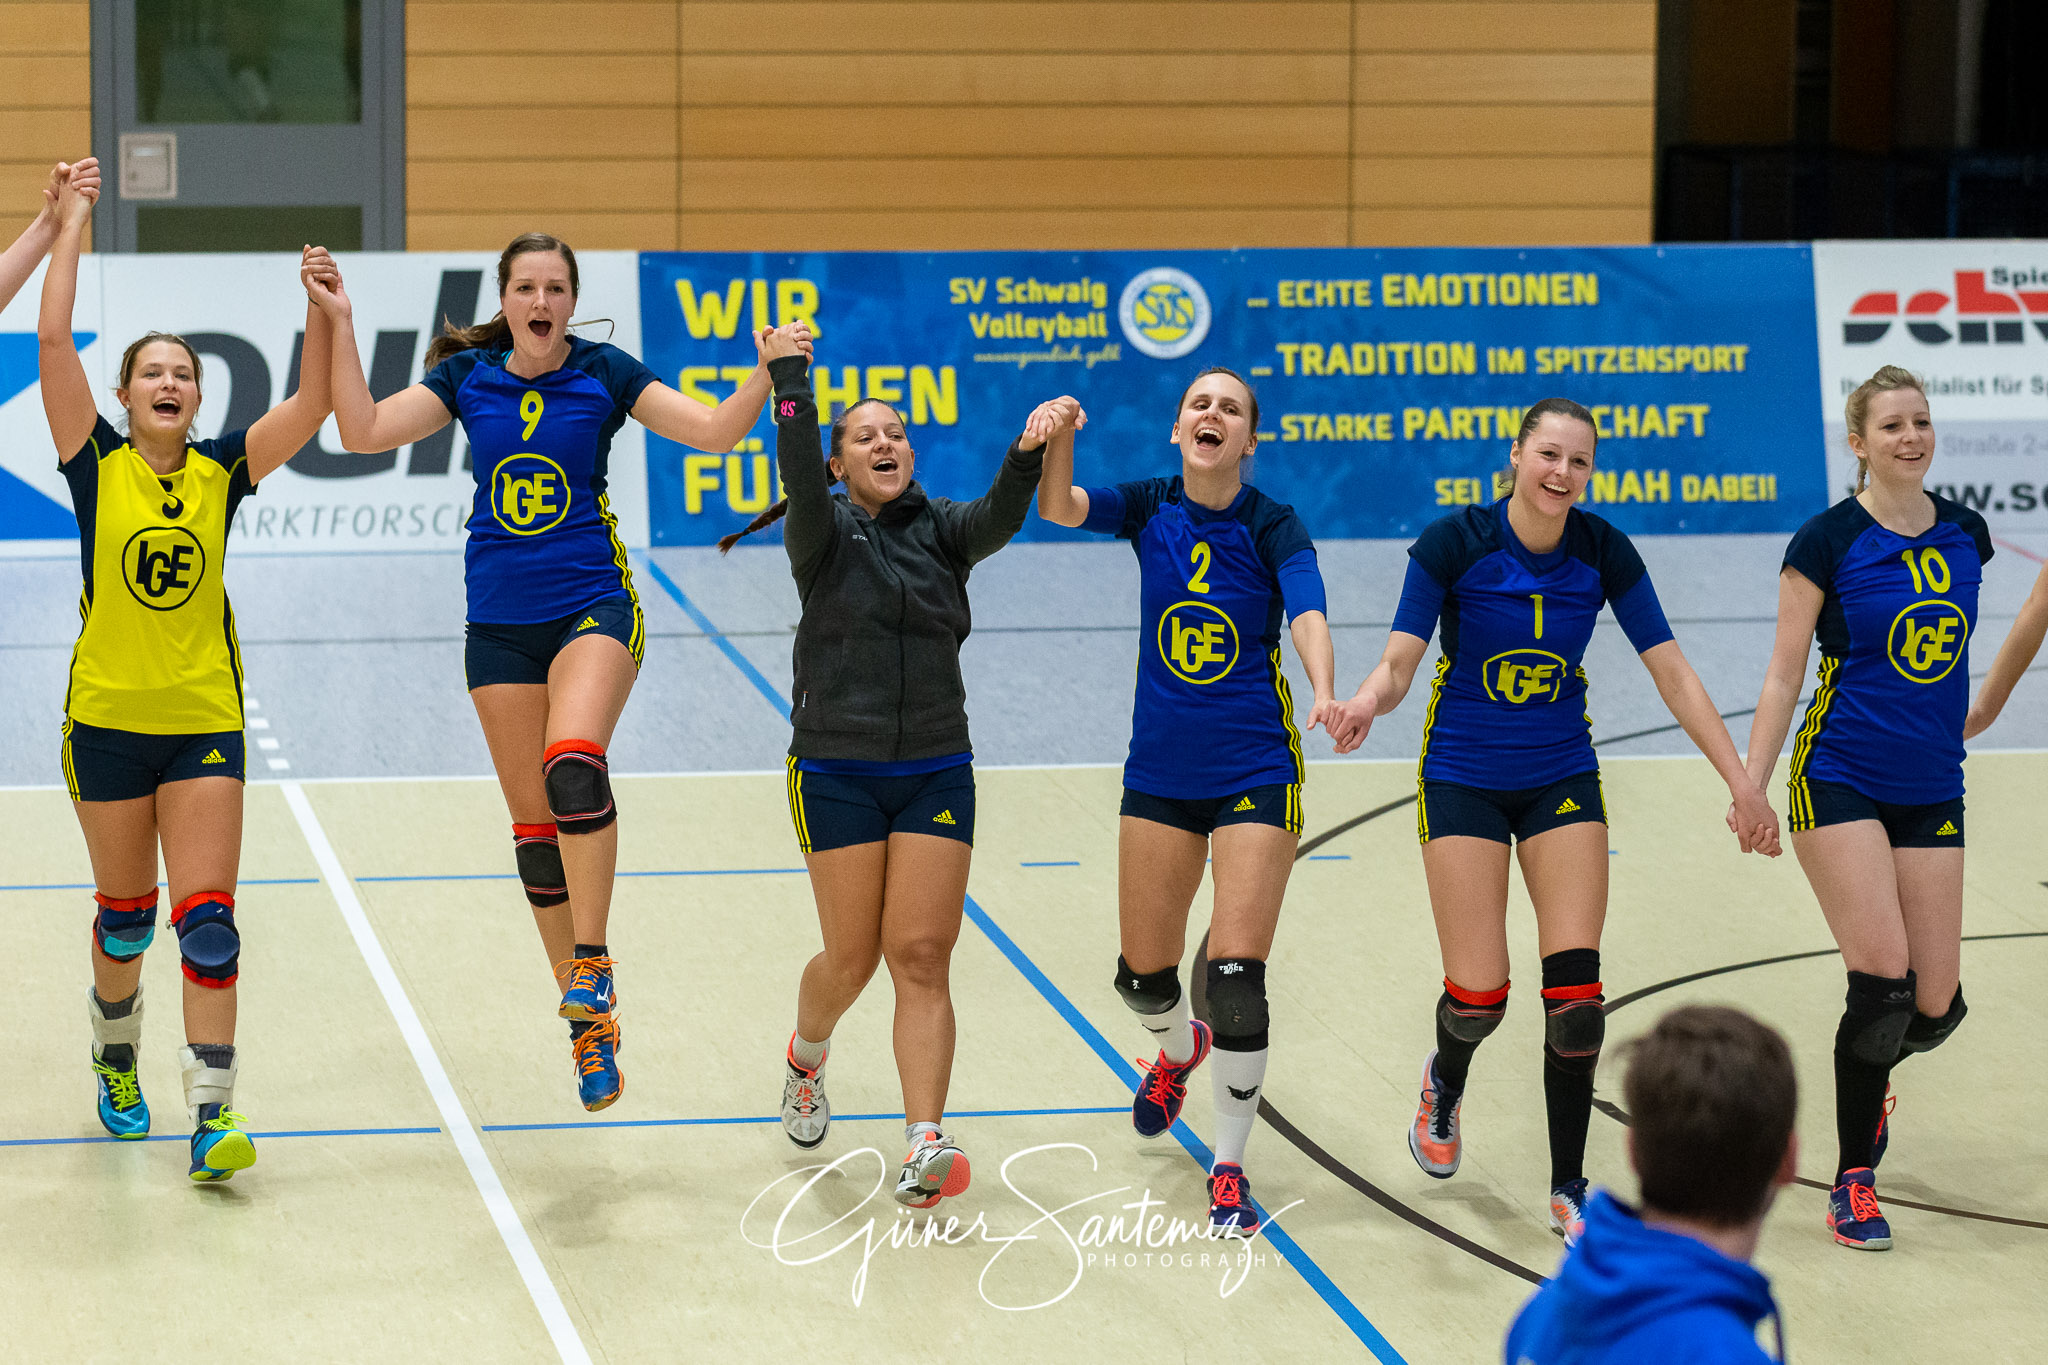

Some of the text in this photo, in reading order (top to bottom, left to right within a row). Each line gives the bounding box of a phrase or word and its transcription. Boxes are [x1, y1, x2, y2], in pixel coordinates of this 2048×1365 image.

[949, 277, 1107, 309] SV Schwaig
[1278, 280, 1372, 307] ECHTE
[1382, 273, 1599, 307] EMOTIONEN
[675, 279, 821, 338] WIR
[1843, 270, 2048, 345] sch
[969, 312, 1108, 343] Volleyball
[1276, 342, 1477, 376] TRADITION
[1487, 347, 1526, 374] IM
[1535, 344, 1748, 374] SPITZENSPORT
[678, 365, 957, 426] STHEN
[519, 390, 545, 442] 9
[1281, 413, 1393, 442] STARKE
[1403, 404, 1710, 441] PARTNCHAFT
[683, 438, 788, 515] FÜ
[1435, 478, 1482, 506] SEI
[232, 503, 467, 538] ARKTFORSC
[1187, 541, 1211, 594] 2
[1901, 546, 1951, 594] 10
[577, 621, 599, 632] adidas
[1529, 594, 1544, 640] 1
[933, 816, 956, 825] adidas
[1234, 803, 1256, 812] adidas
[1556, 804, 1581, 815] adidas
[1936, 828, 1959, 836] adidas
